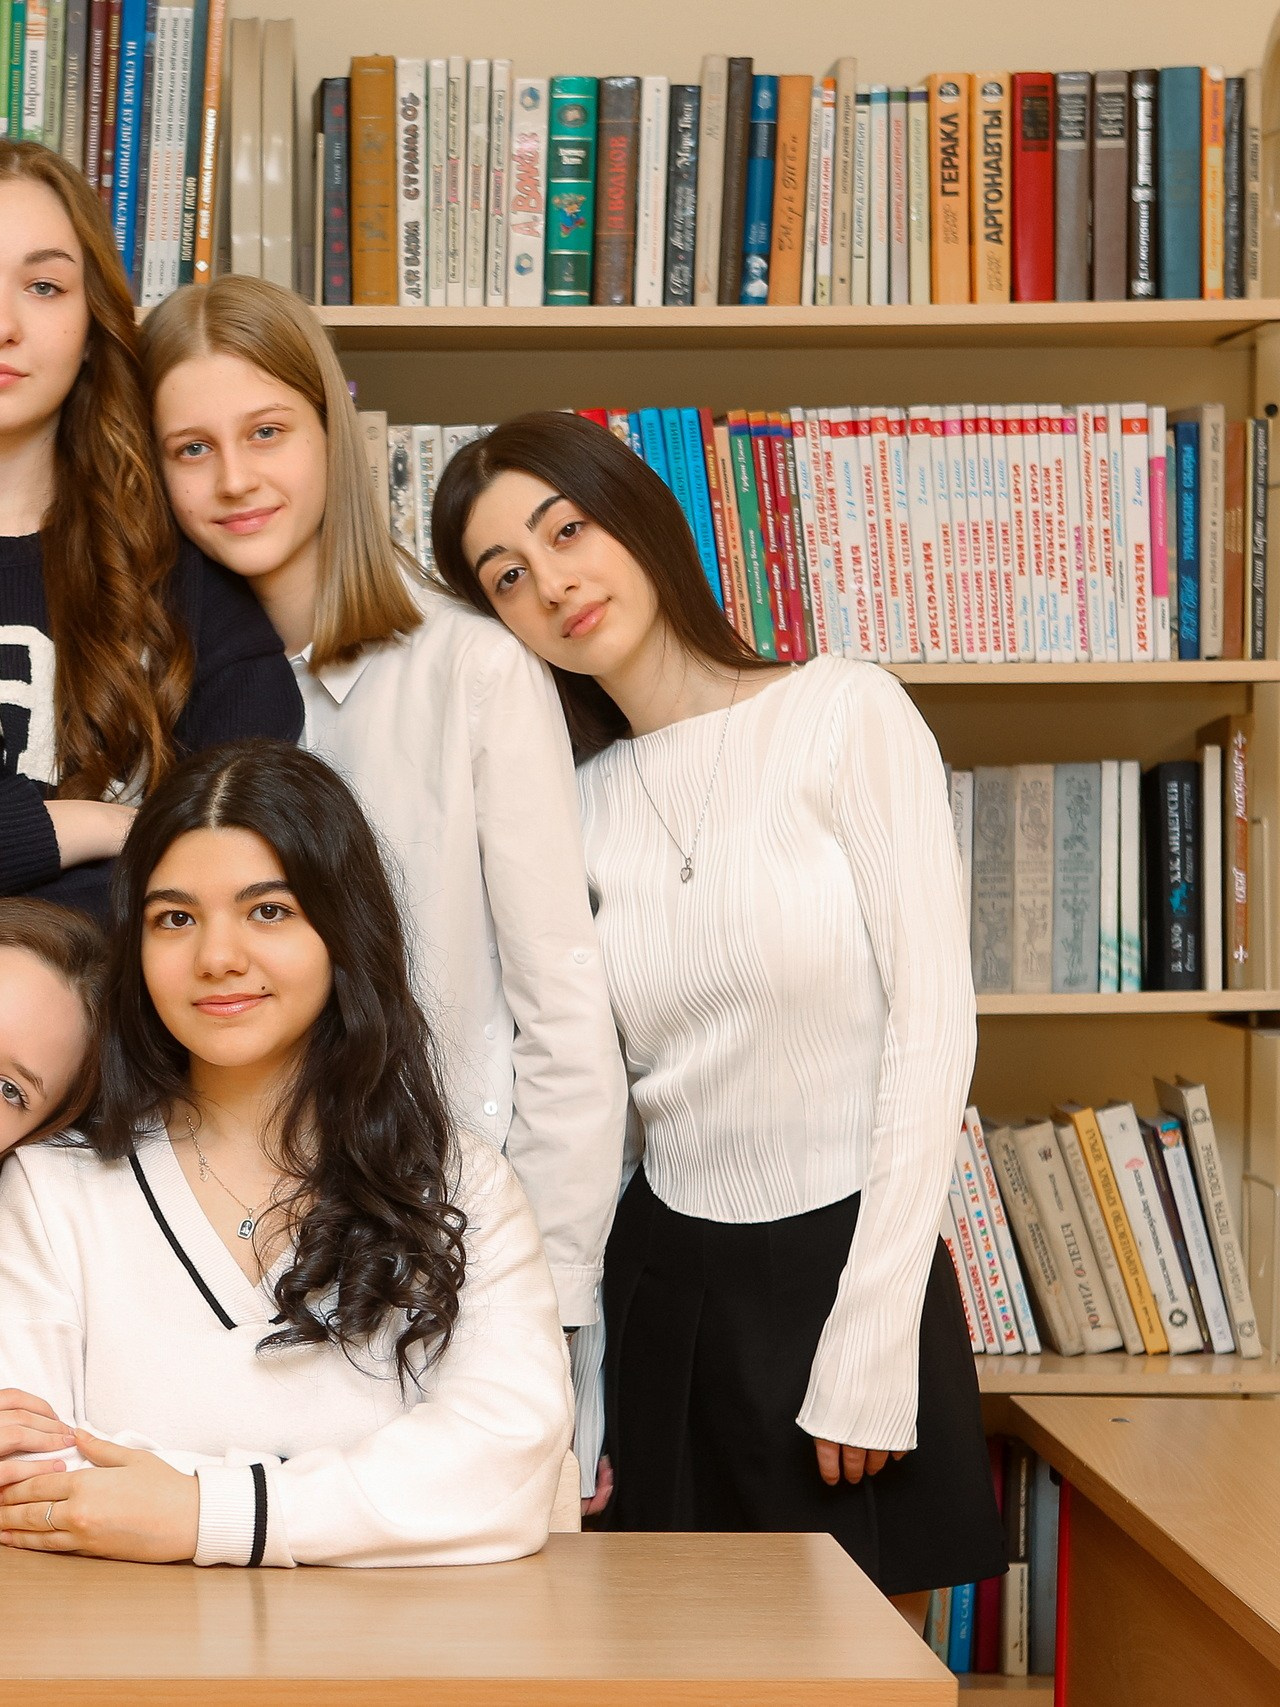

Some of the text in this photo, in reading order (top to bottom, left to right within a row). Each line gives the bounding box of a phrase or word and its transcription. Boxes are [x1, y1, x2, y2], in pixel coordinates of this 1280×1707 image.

[23, 50, 41, 118] Мифология
[116, 41, 136, 252] НА СТРАЖЕ КУЛЬТУРНОГО НАСЛЕДИЯ
[332, 163, 343, 185] МАРК
[401, 124, 421, 201] СТРАНА
[939, 113, 960, 198] ГЕРАКЛ
[982, 110, 1004, 246] АРГОНАВТЫ
[777, 196, 802, 252] Марк
[855, 198, 865, 248] АЛЬФРЕД
[765, 516, 778, 553] Гулливер
[782, 514, 797, 590] Руслан Людмила
[823, 451, 847, 595] ХОЗЯЙКА МЕДНОЙ ГОРЫ
[861, 464, 888, 653] СМЕШНЫЕ РАССКАЗЫ ШКОЛЕ
[878, 441, 900, 598] ПРИКЛЮЧЕНИЯ ЭЛЕКТРОНИКА
[1010, 464, 1027, 577] РОБИНЗОН КРУЗО
[1028, 463, 1044, 577] РОБИНЗОН КРУЗО
[1041, 468, 1056, 581] УРАЛЬСКИЕ СКАЗЫ
[1054, 458, 1070, 597] ТИМУР ЕГО КОМАНДА
[1098, 458, 1114, 579] МЯГКИЙ ХАРАКТЕР
[1252, 521, 1267, 594] Агния Барто
[751, 561, 764, 605] Александр
[771, 563, 787, 631] Джонатан Свифт
[806, 522, 829, 654] ВНЕКЛАССНОЕ ЧТЕНИЕ
[850, 545, 872, 654] ХРЕСТОМАТИЯ
[898, 522, 920, 654] ВНЕКЛАССНОЕ ЧТЕНИЕ
[921, 542, 941, 651] ХРЕСТОМАТИЯ
[940, 522, 961, 654] ВНЕКЛАССНОЕ ЧТЕНИЕ
[955, 522, 975, 654] ВНЕКЛАССНОЕ ЧТЕНИЕ
[969, 522, 988, 654] ВНЕКЛАССНОЕ ЧТЕНИЕ
[983, 522, 1002, 654] ВНЕКЛАССНОЕ ЧТЕНИЕ
[999, 522, 1018, 654] ВНЕКЛАССНОЕ ЧТЕНИЕ
[1072, 526, 1089, 653] ДОМОВЁНОК КУЗЬКА
[1133, 544, 1149, 653] ХРЕСТОМАТИЯ
[1166, 781, 1179, 856] АНДЕРСЕН
[1085, 1127, 1140, 1279] КОРОЛЕВСТВО КРИВЫХ ЗЕРКАЛ
[1200, 1143, 1233, 1241] ПЕТРА ТВОРЕНЬЕ
[957, 1217, 996, 1345] ВНЕКЛАССНОЕ ЧТЕНИЕ
